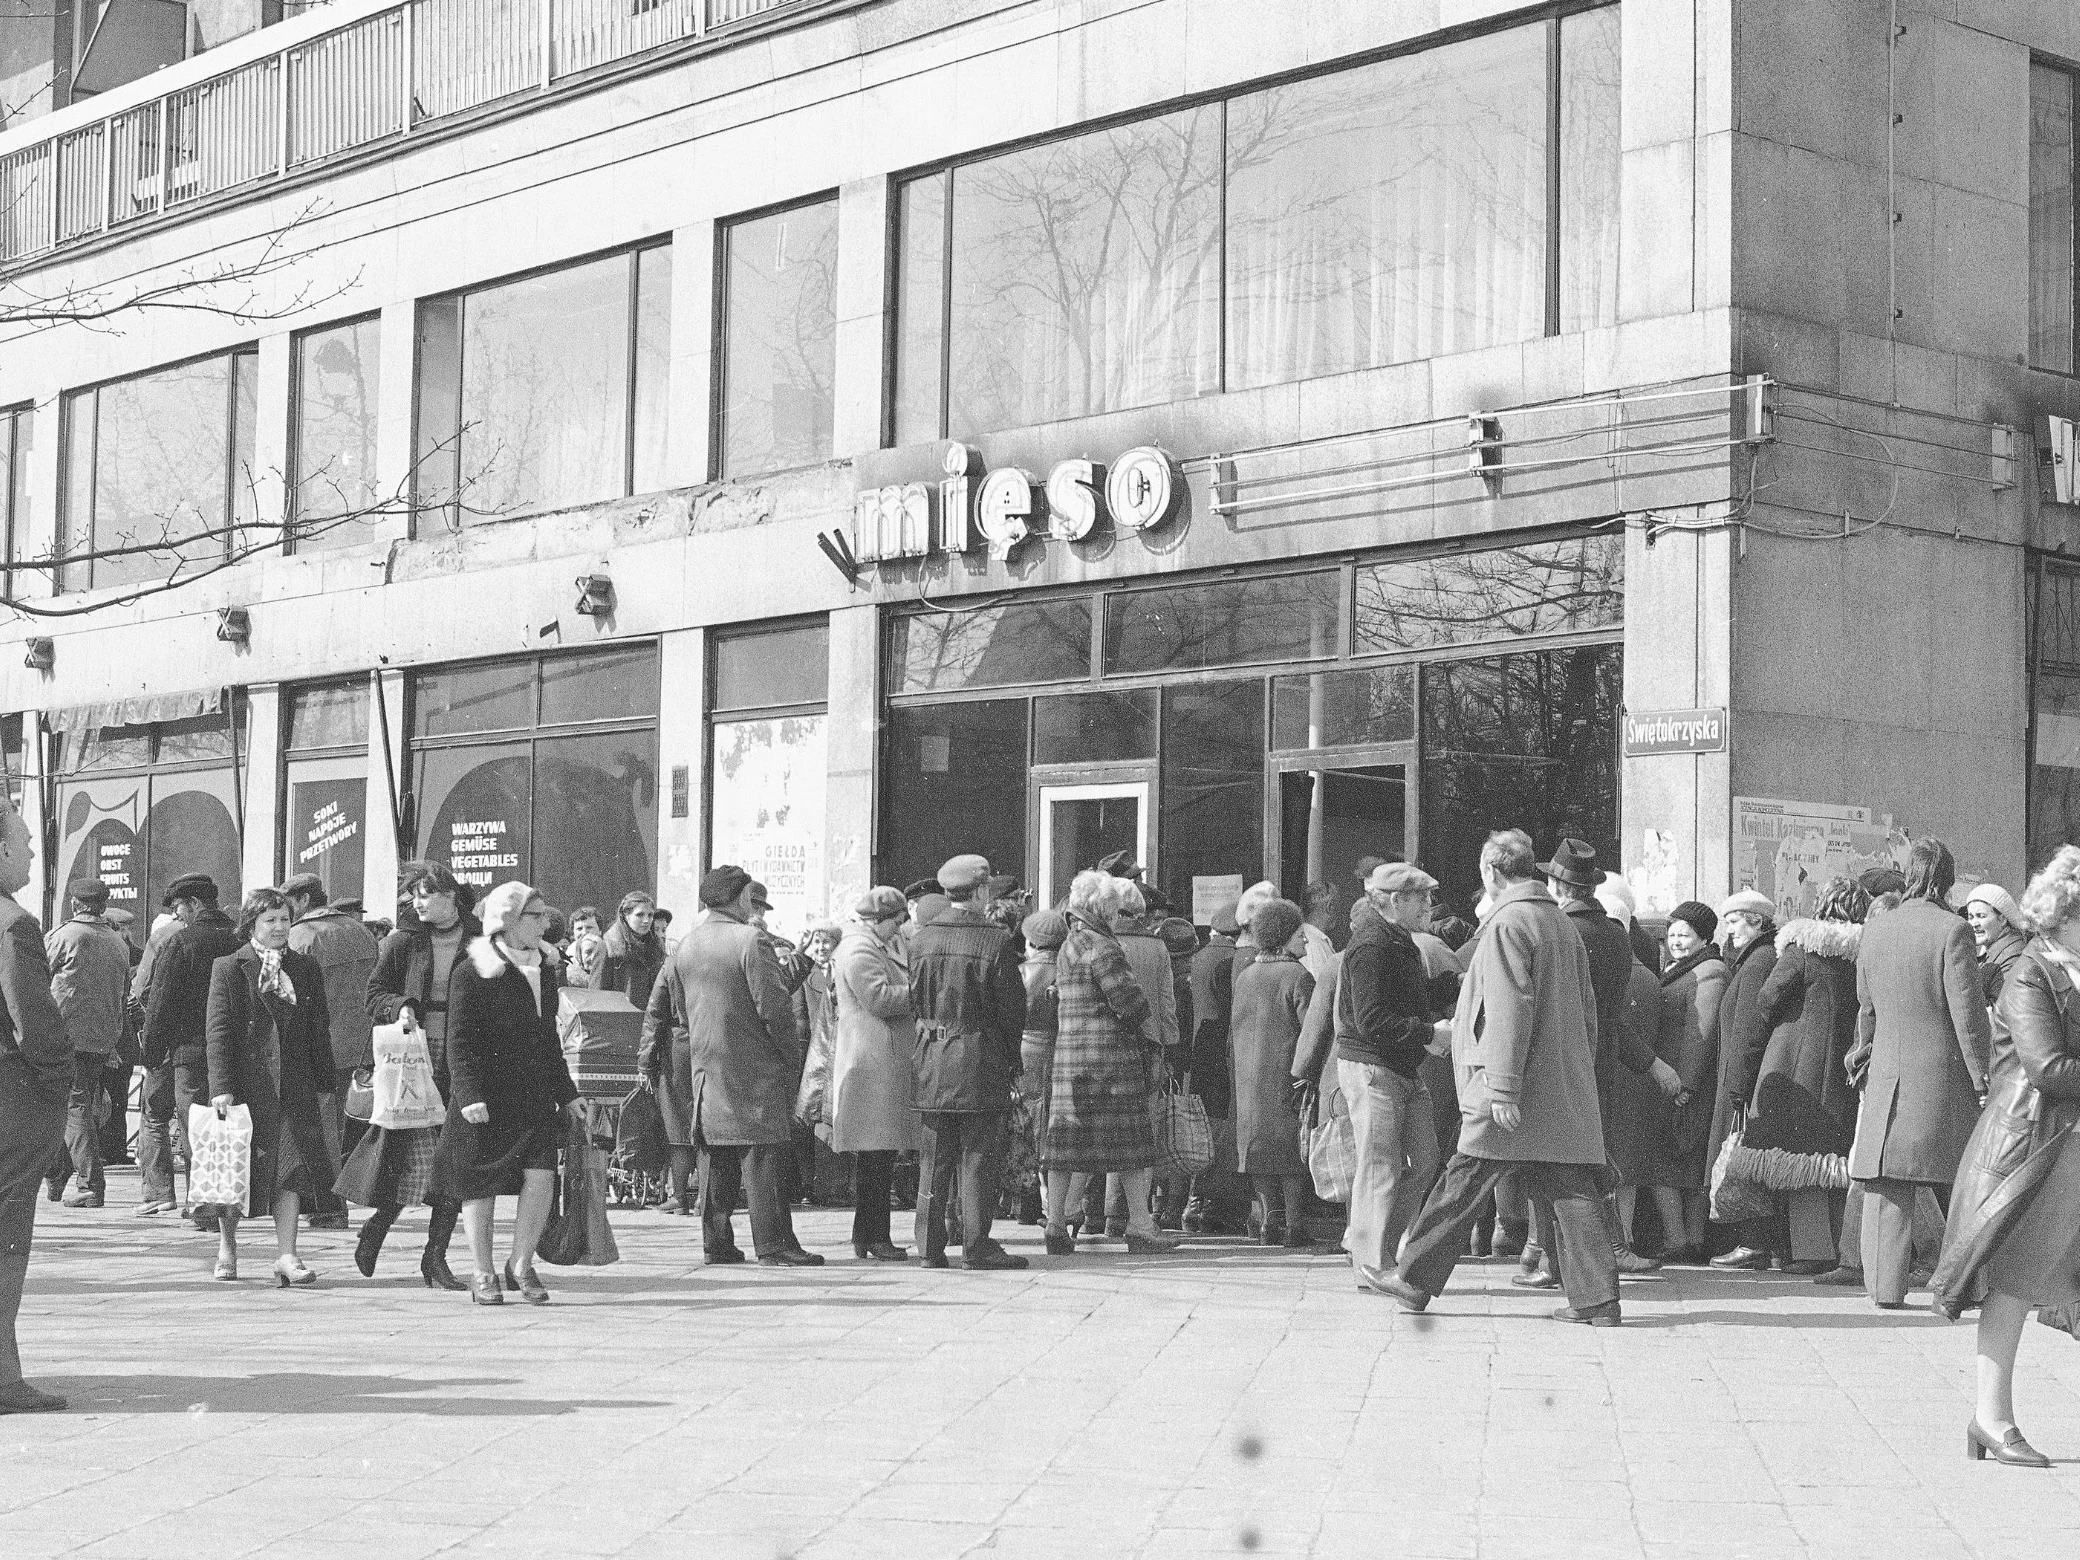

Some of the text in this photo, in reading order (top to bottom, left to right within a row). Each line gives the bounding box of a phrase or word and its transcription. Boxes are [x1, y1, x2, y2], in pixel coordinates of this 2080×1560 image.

[1627, 714, 1719, 747] Świętokrzyska
[313, 800, 338, 824] SOKI
[308, 811, 347, 842] NAPOJE
[451, 820, 507, 836] WARZYWA
[1741, 816, 1775, 838] Kwintet
[1776, 817, 1825, 840] Kazimia
[100, 843, 131, 857] OWOCE
[299, 820, 357, 864] PRZETWORY
[451, 835, 497, 852] GEMÜSE
[765, 845, 805, 858] GIEŁDA
[100, 858, 123, 871] OBST
[451, 853, 519, 869] VEGETABLES
[99, 872, 130, 886] FRUITS
[107, 886, 138, 900] РУКТЫ
